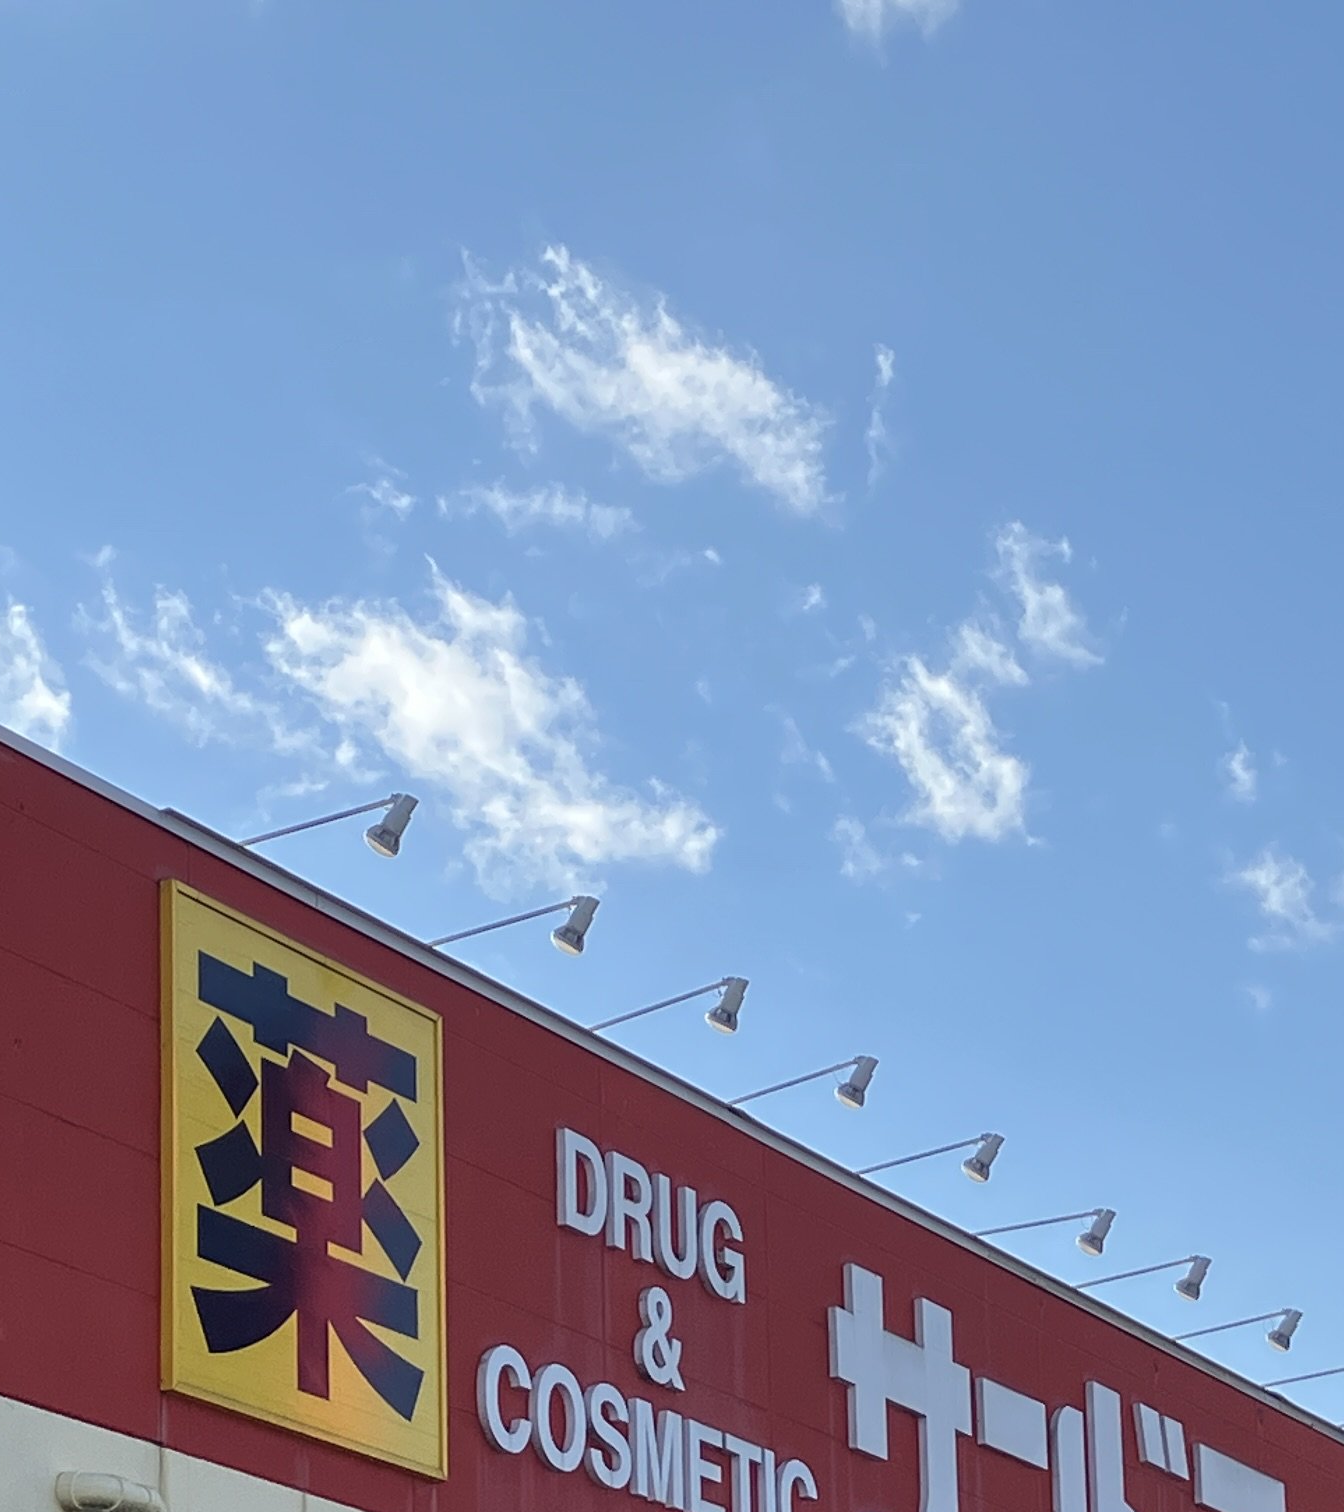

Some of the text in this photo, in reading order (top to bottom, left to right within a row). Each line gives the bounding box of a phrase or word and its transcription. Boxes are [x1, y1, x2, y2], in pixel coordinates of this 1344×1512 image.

[189, 948, 425, 1421] 薬
[555, 1126, 745, 1304] DRUG
[634, 1286, 684, 1390] &
